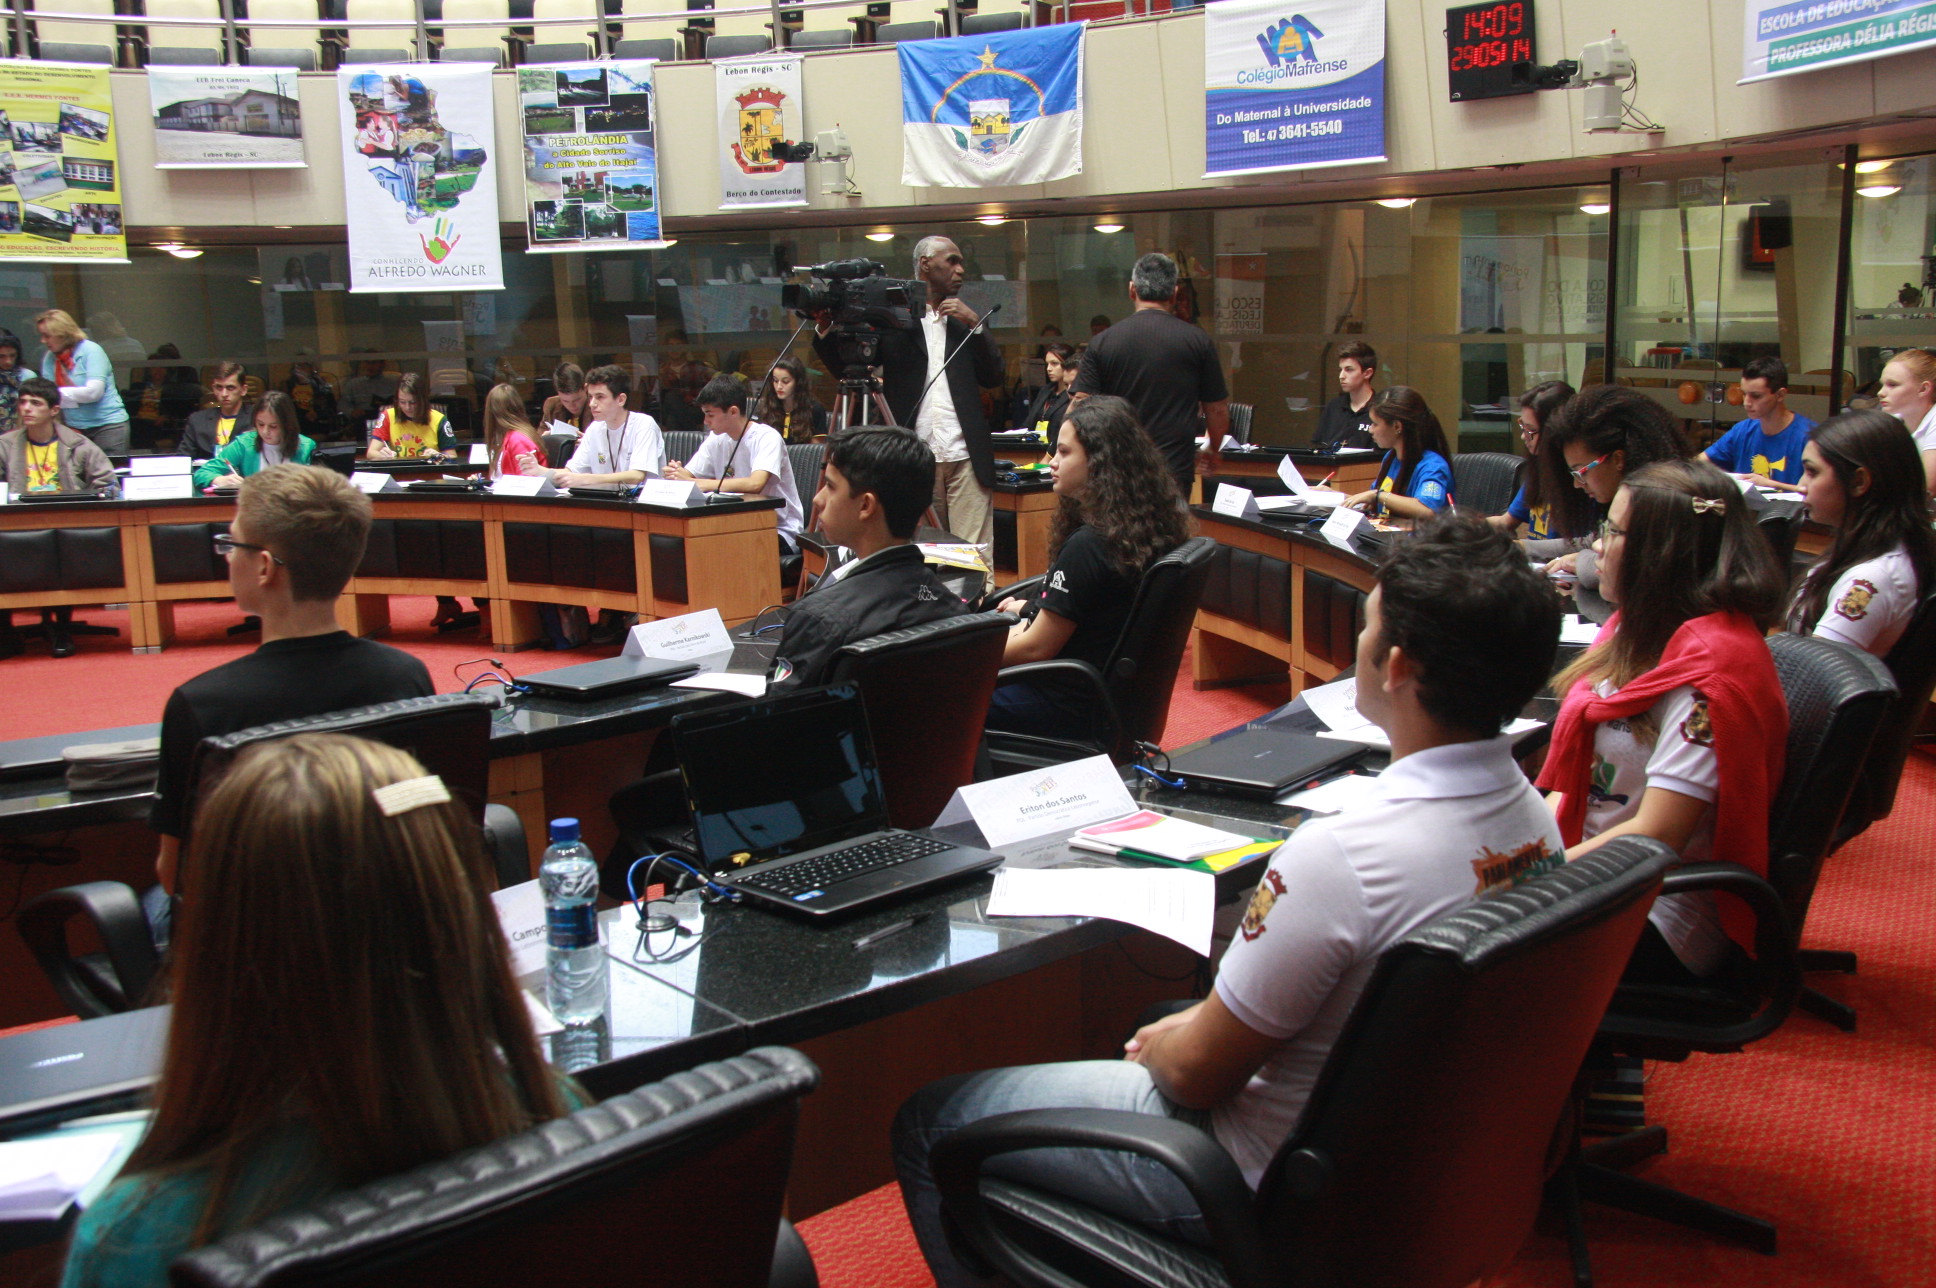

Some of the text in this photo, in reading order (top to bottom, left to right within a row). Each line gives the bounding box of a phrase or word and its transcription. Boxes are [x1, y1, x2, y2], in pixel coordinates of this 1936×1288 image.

[1463, 2, 1523, 40] 14:09
[1759, 11, 1807, 35] ESCOLA
[1807, 6, 1824, 23] DE
[1770, 32, 1851, 64] PROFESSORA
[1854, 23, 1894, 46] DÉLIA
[725, 68, 749, 76] Lebon
[781, 64, 793, 72] SC
[1216, 96, 1372, 125] Do Maternal à Universidade
[1266, 129, 1277, 141] 47
[1279, 119, 1343, 140] 3641-5540
[549, 134, 628, 147] PETROLÂNDIA
[560, 149, 591, 157] Cidade
[593, 148, 626, 156] Sorriso
[543, 160, 554, 169] do
[557, 160, 575, 168] Alto
[577, 159, 597, 168] Vale
[599, 159, 610, 167] do
[726, 190, 747, 198] Berço
[760, 187, 801, 196] Contestado
[368, 264, 486, 278] ALFREDO WAGNER
[1019, 793, 1087, 815] Eriton dos Santos
